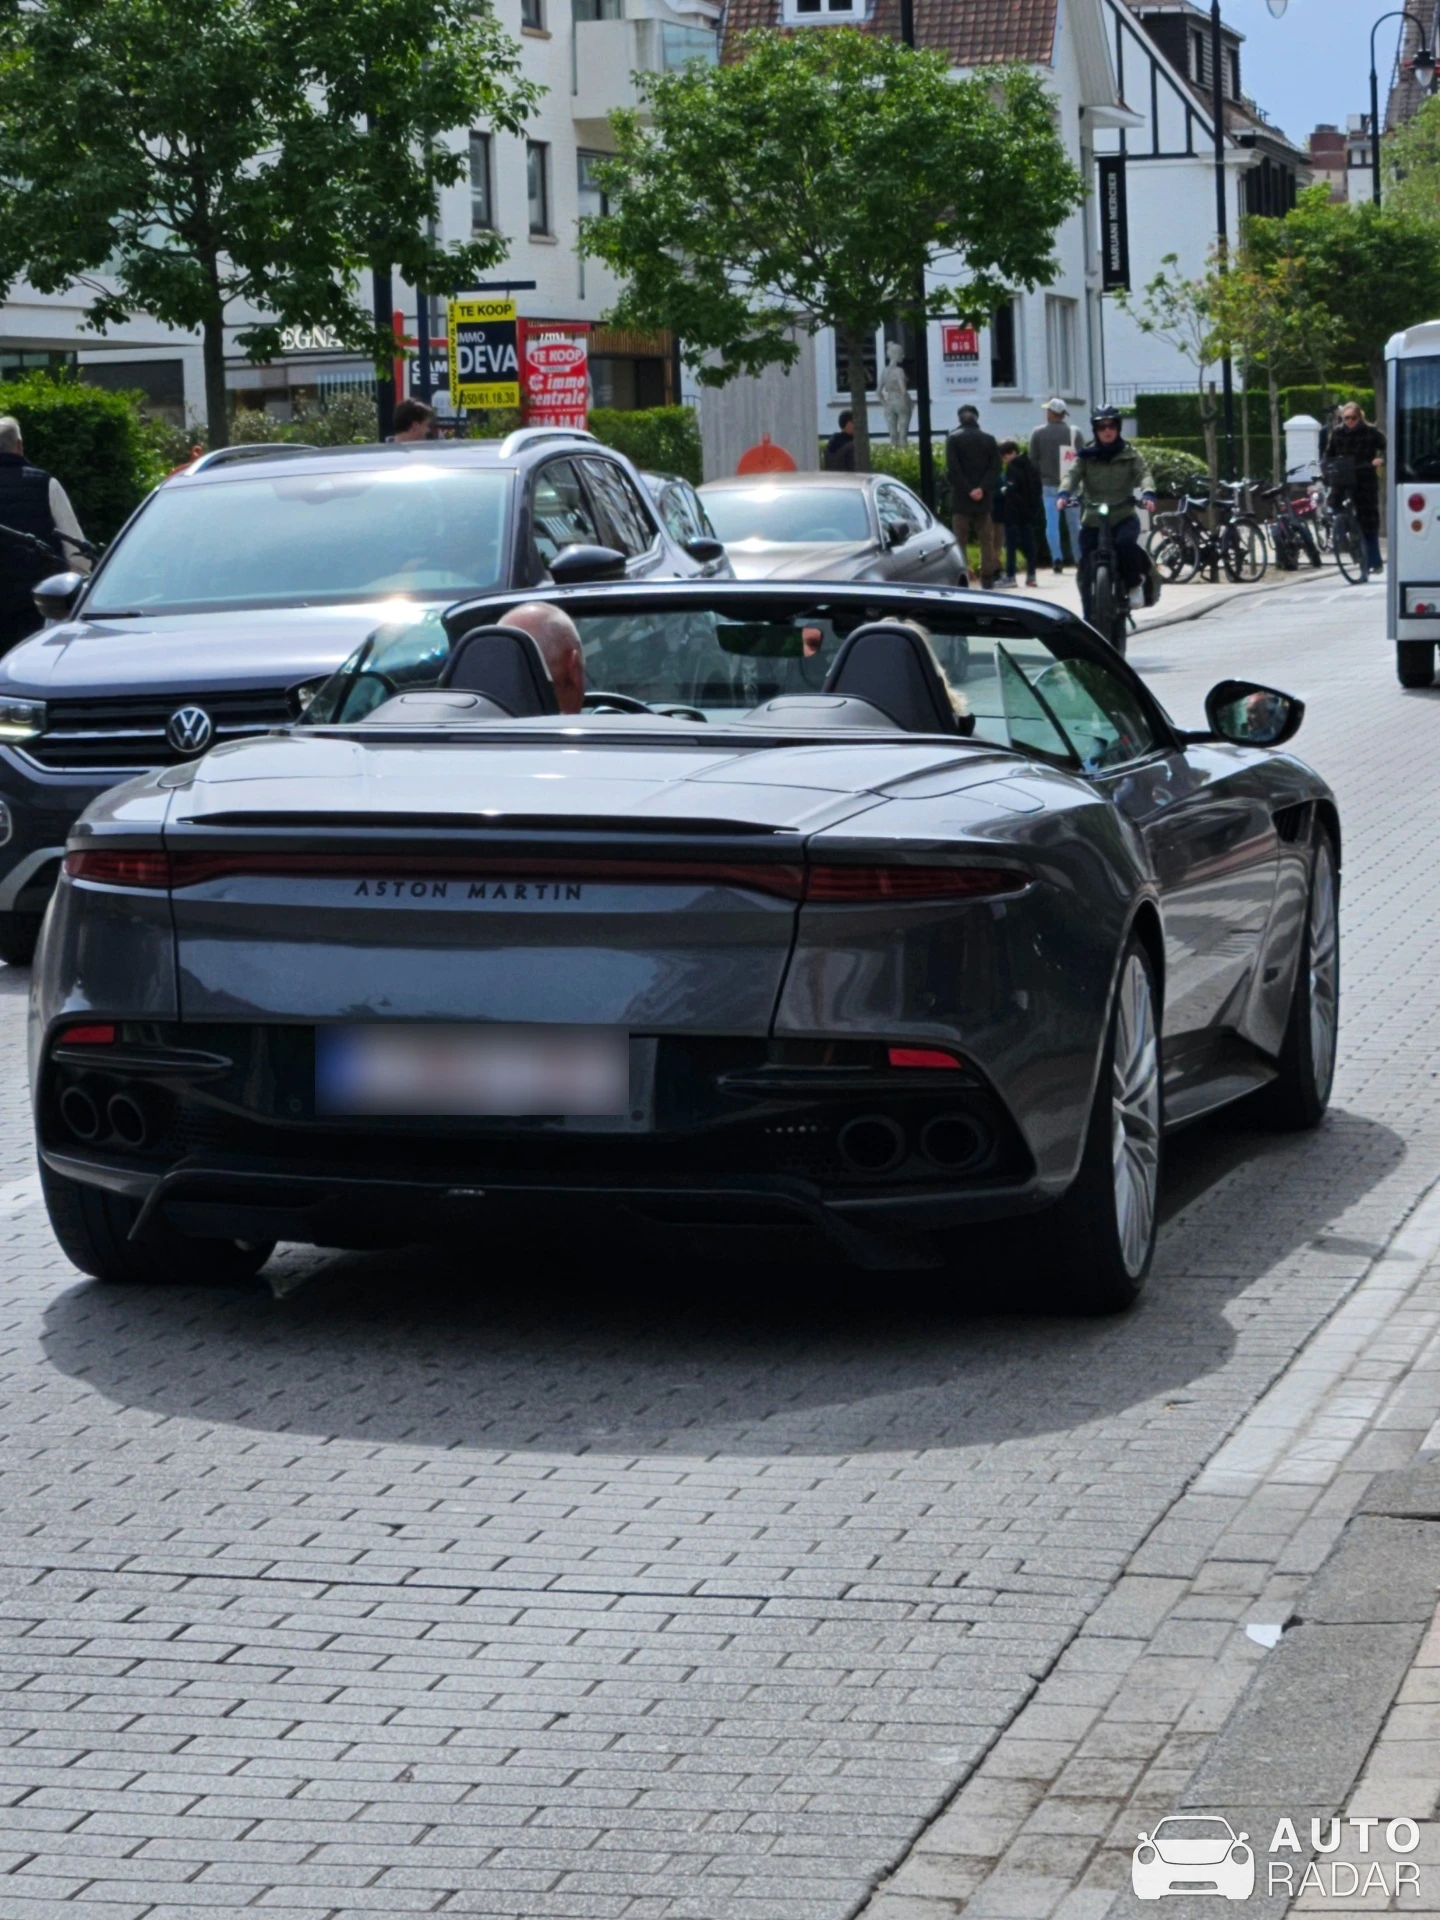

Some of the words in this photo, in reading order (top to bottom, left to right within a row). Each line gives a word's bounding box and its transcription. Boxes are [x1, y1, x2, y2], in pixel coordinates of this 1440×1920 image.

[459, 305, 474, 317] TE
[477, 304, 512, 316] KOOP
[457, 344, 519, 375] DEVA
[533, 350, 547, 363] TE
[549, 348, 582, 362] KOOP
[547, 373, 586, 391] immo
[354, 880, 448, 898] ASTON
[467, 883, 582, 900] MARTIN
